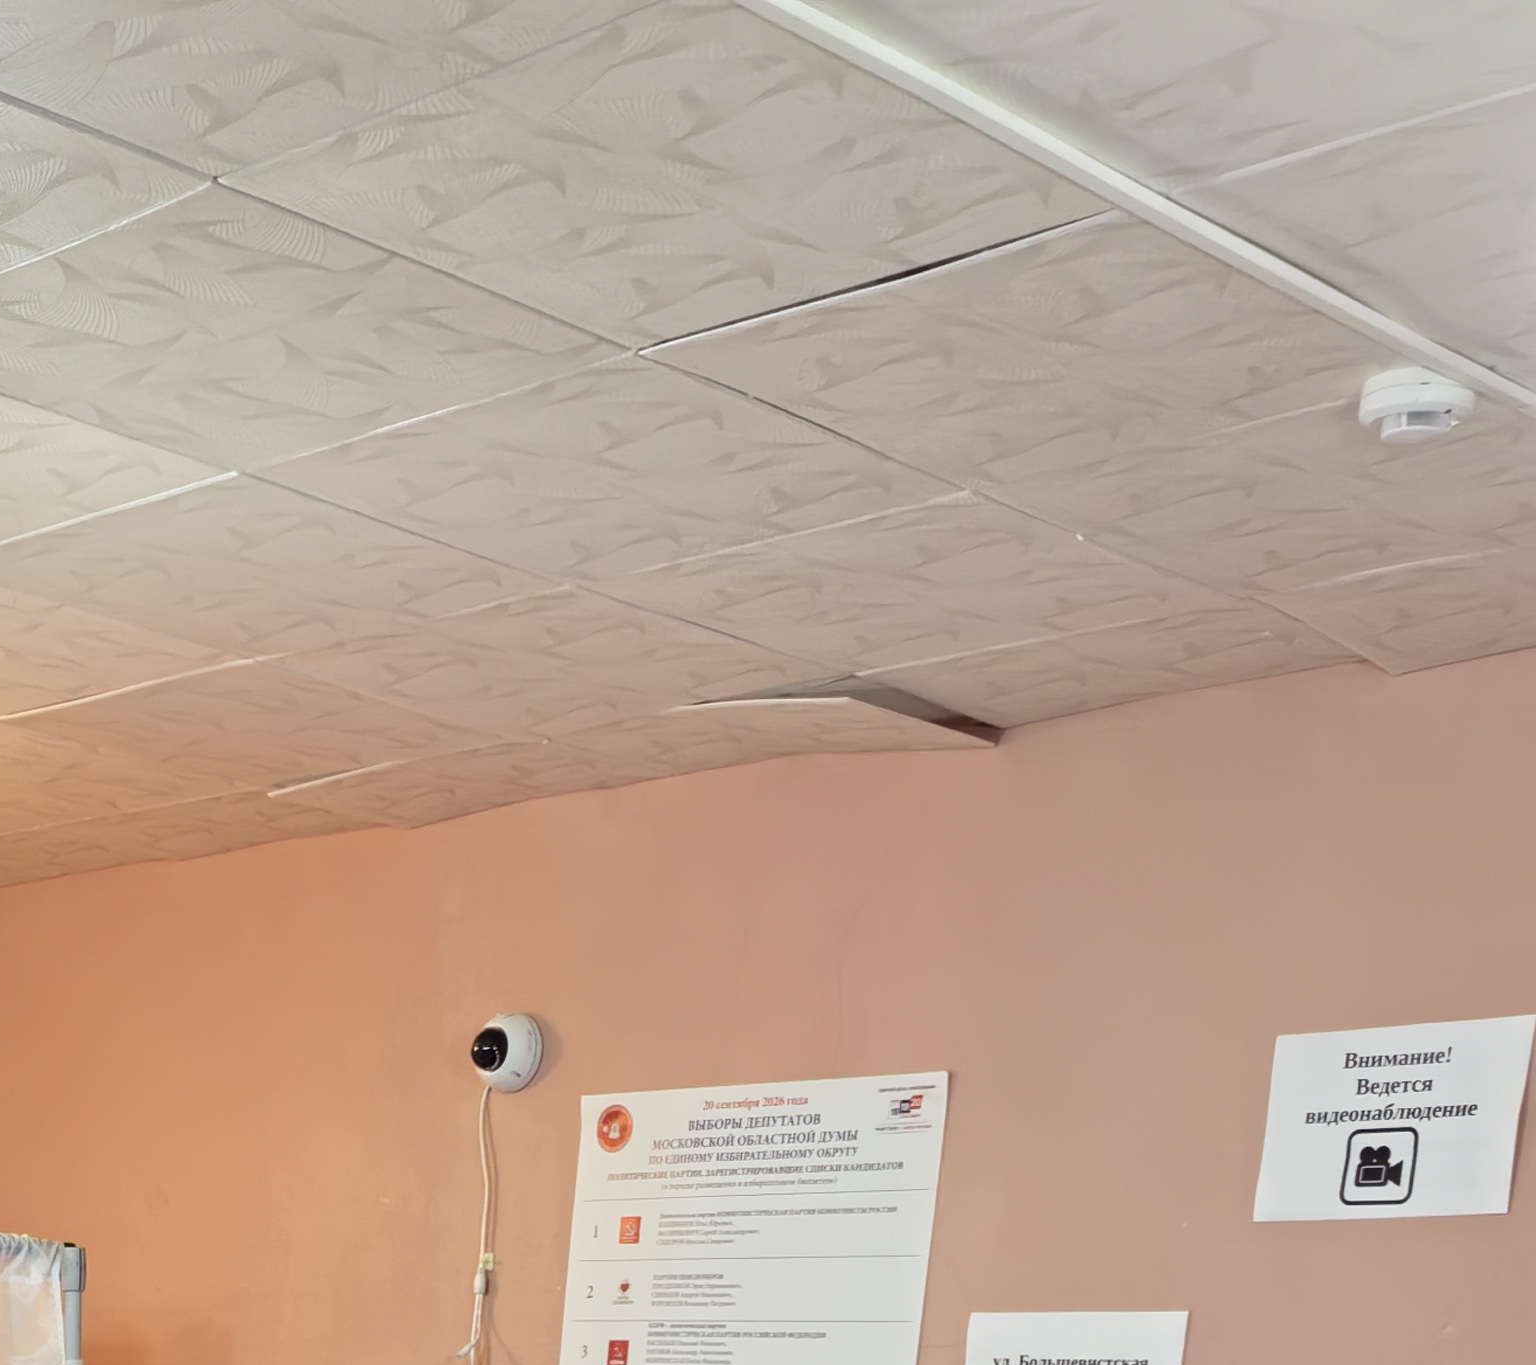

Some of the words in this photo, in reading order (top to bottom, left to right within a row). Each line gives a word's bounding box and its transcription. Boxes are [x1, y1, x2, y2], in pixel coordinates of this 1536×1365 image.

[1343, 1046, 1453, 1069] Внимание!
[1355, 1078, 1433, 1097] Ведется
[703, 1100, 714, 1111] 20
[716, 1097, 760, 1111] сентября
[762, 1096, 785, 1107] 2026
[787, 1096, 809, 1107] года
[688, 1117, 742, 1132] ВЫБОРЫ
[745, 1113, 822, 1131] ДЕПУТАТОВ
[1305, 1102, 1478, 1126] видеонаблюдение
[652, 1134, 734, 1151] МОСКОВСКОЙ
[737, 1130, 815, 1147] ОБЛАСТНОЙ
[818, 1129, 859, 1145] ДУМЫ
[648, 1155, 663, 1165] ПО
[665, 1152, 714, 1165] ЕДИНОМУ
[716, 1148, 814, 1162] ИЗБИРАТЕЛЬНОМУ
[816, 1146, 860, 1158] ОКРУГУ
[593, 1225, 598, 1238] 1
[586, 1285, 594, 1299] 2
[580, 1345, 588, 1359] 3
